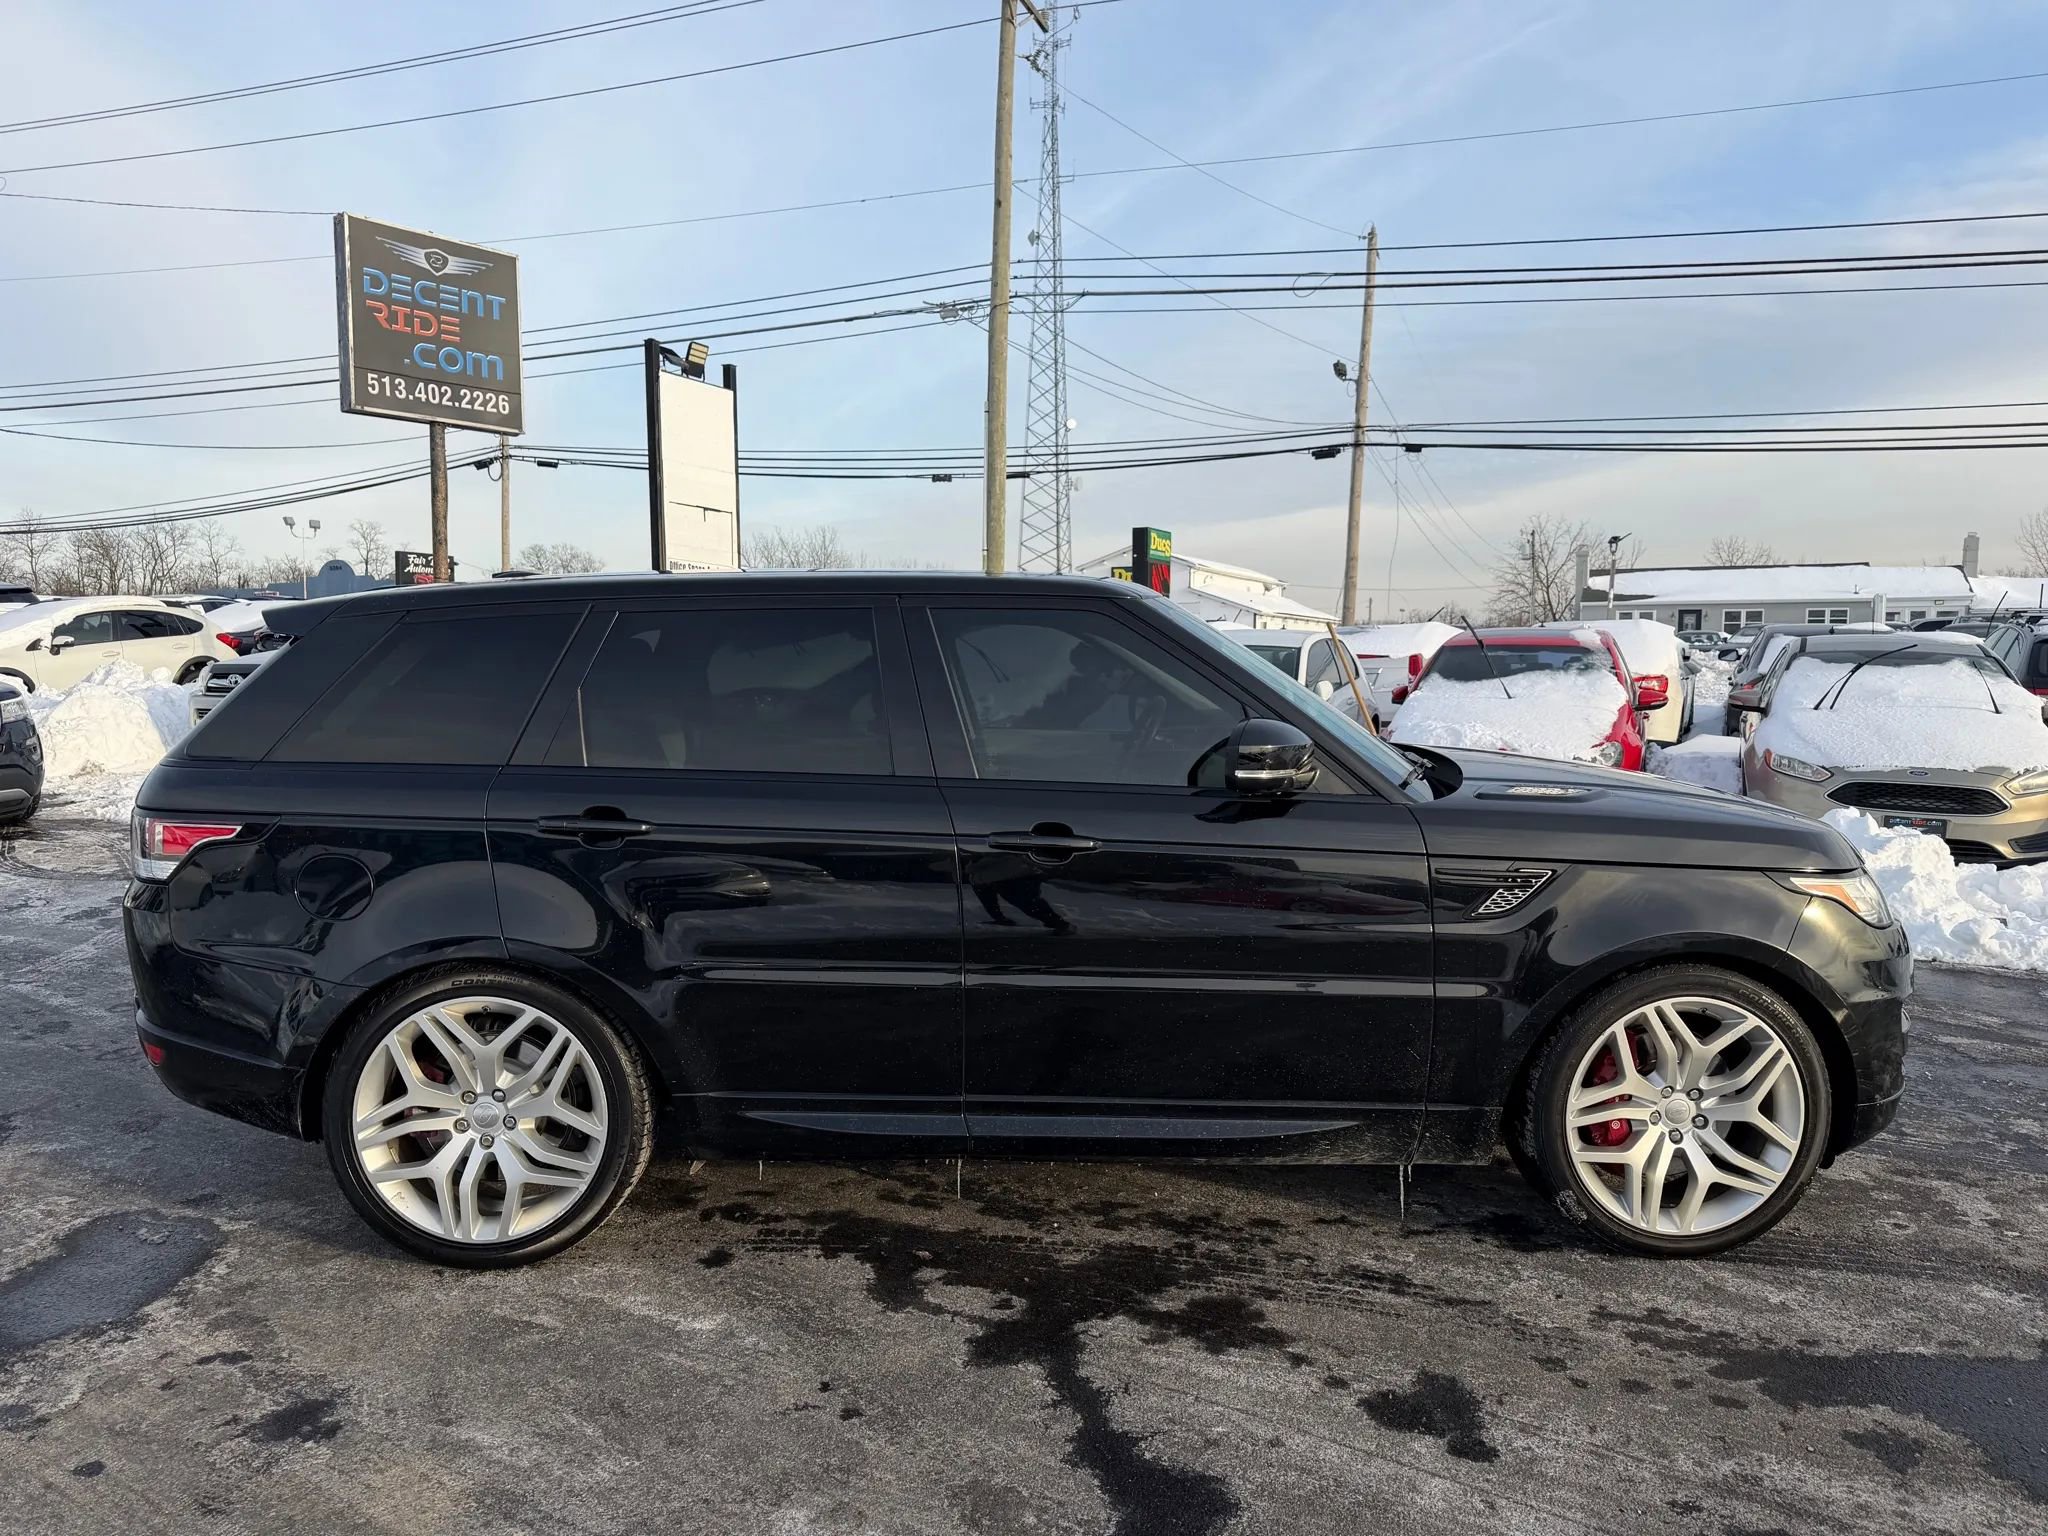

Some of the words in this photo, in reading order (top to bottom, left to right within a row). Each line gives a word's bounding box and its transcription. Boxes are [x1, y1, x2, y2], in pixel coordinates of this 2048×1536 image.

[363, 267, 506, 320] DECENT
[366, 300, 460, 342] RIDE
[367, 372, 510, 415] 513.402.2226
